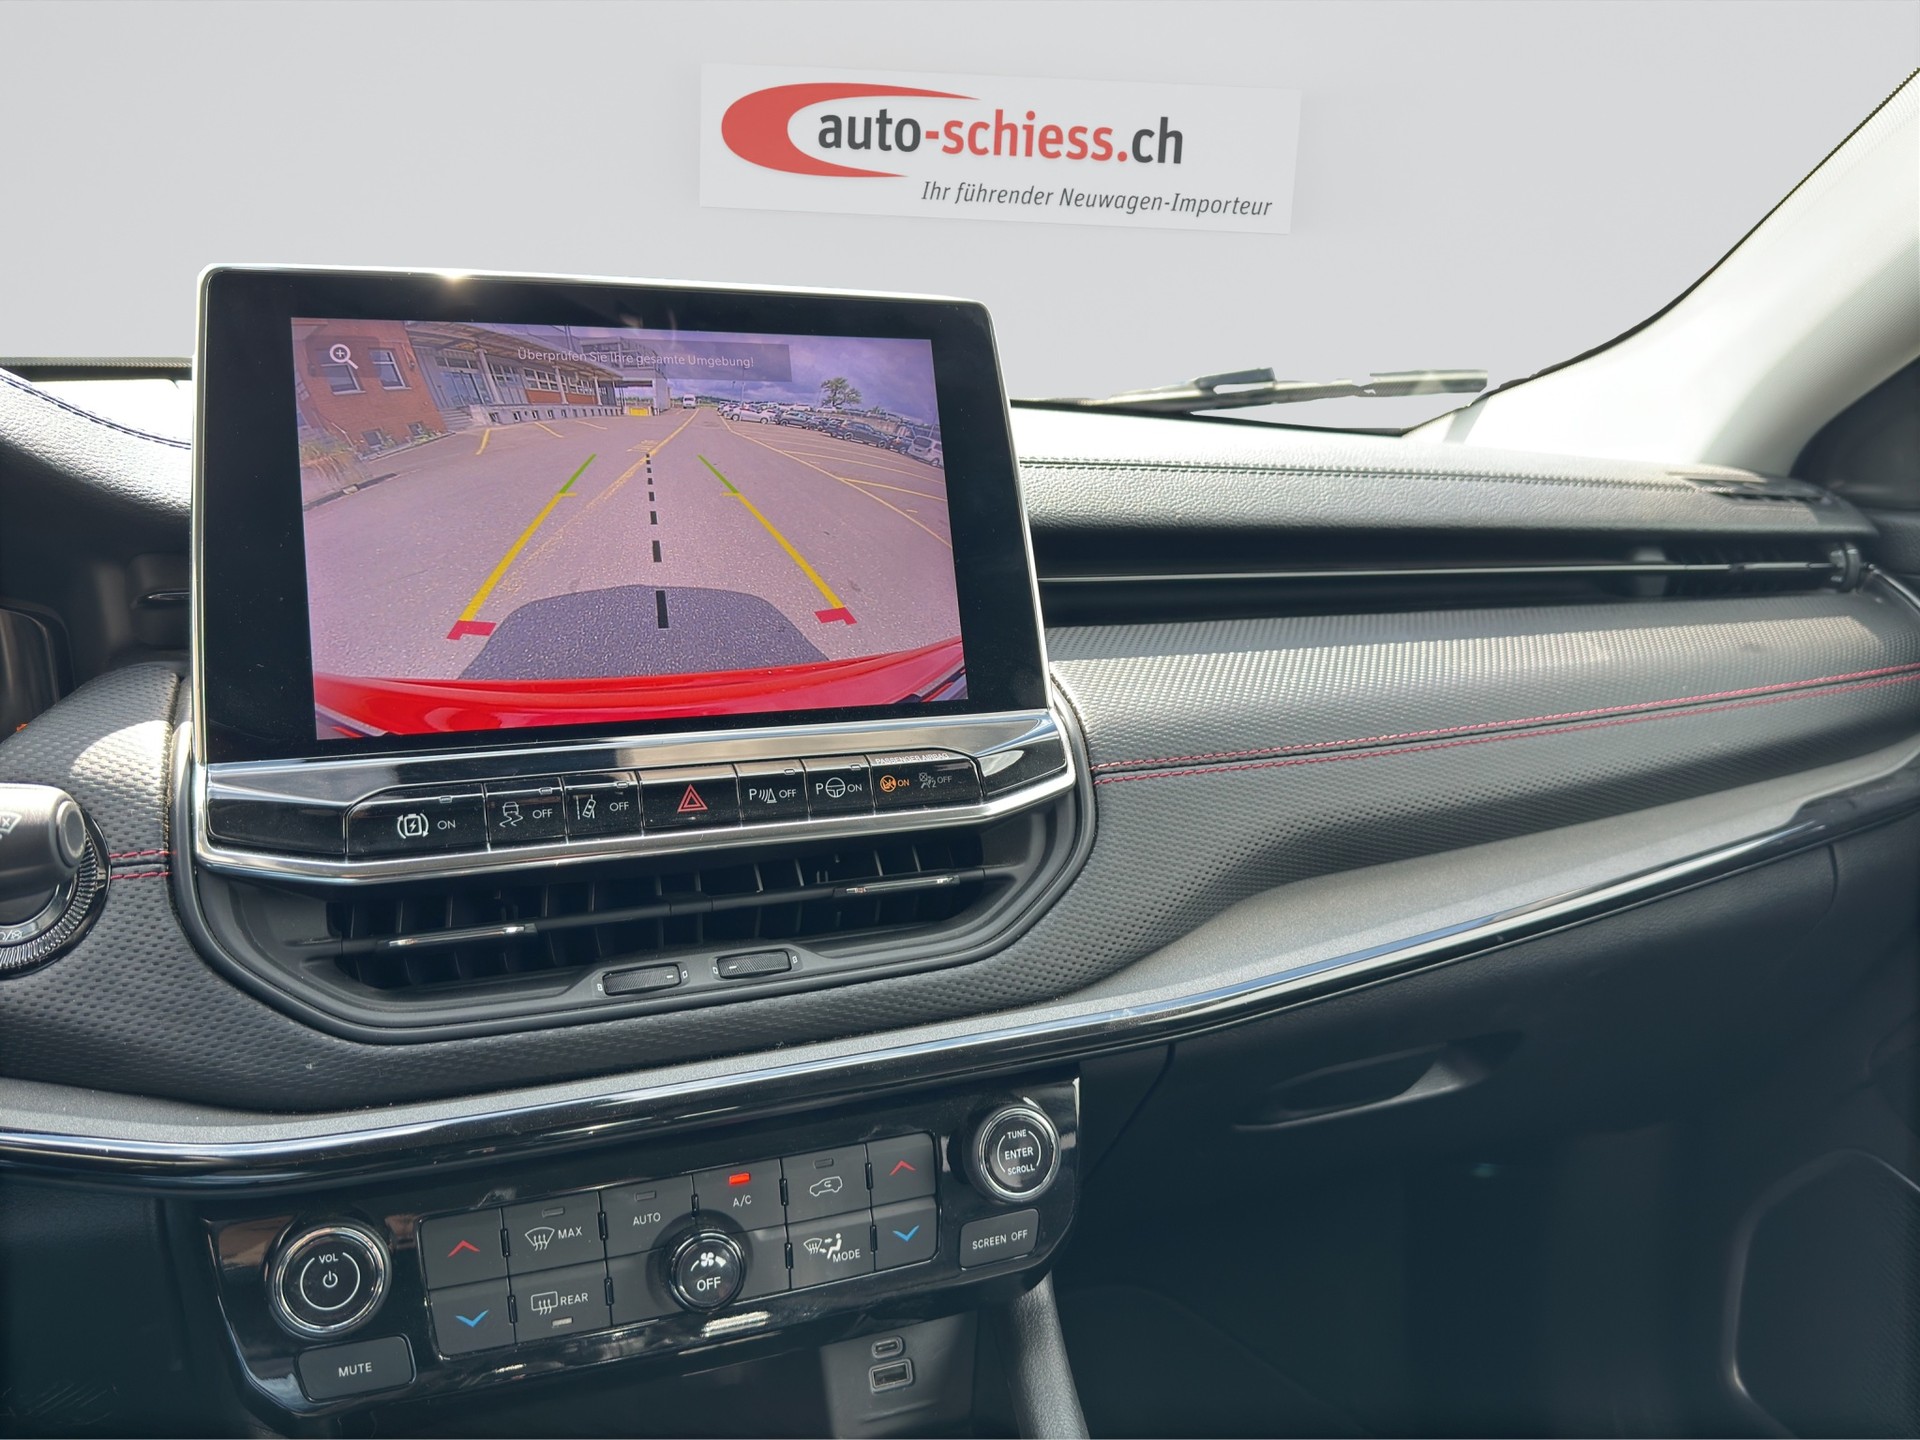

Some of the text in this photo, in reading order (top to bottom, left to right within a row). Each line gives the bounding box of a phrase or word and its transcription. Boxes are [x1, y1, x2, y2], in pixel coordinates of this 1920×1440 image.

[817, 108, 1183, 165] auto-schiess.ch
[921, 181, 1273, 217] Ihr führender Neuwagen-Importeur
[517, 347, 754, 369] Überprüfen Sie Ihre gesamte Umgebung!
[875, 752, 949, 765] PASSENGER AIRBAG
[897, 779, 910, 787] ON
[936, 775, 952, 784] OFF
[778, 788, 797, 799] OFF
[846, 783, 863, 793] ON
[532, 808, 553, 820] OFF
[609, 801, 630, 813] OFF
[437, 819, 456, 831] ON
[1007, 1127, 1028, 1140] TUNE
[1003, 1145, 1034, 1160] ENTER
[1007, 1163, 1036, 1176] SCROLL
[732, 1193, 752, 1208] A/C
[632, 1211, 662, 1226] AUTO
[557, 1226, 583, 1240] MAX
[971, 1228, 1029, 1250] SCREEN OFF
[318, 1252, 340, 1264] VOL
[832, 1247, 861, 1263] MODE
[696, 1275, 722, 1292] OFF
[559, 1291, 589, 1306] REAR
[338, 1361, 373, 1378] MUTE
